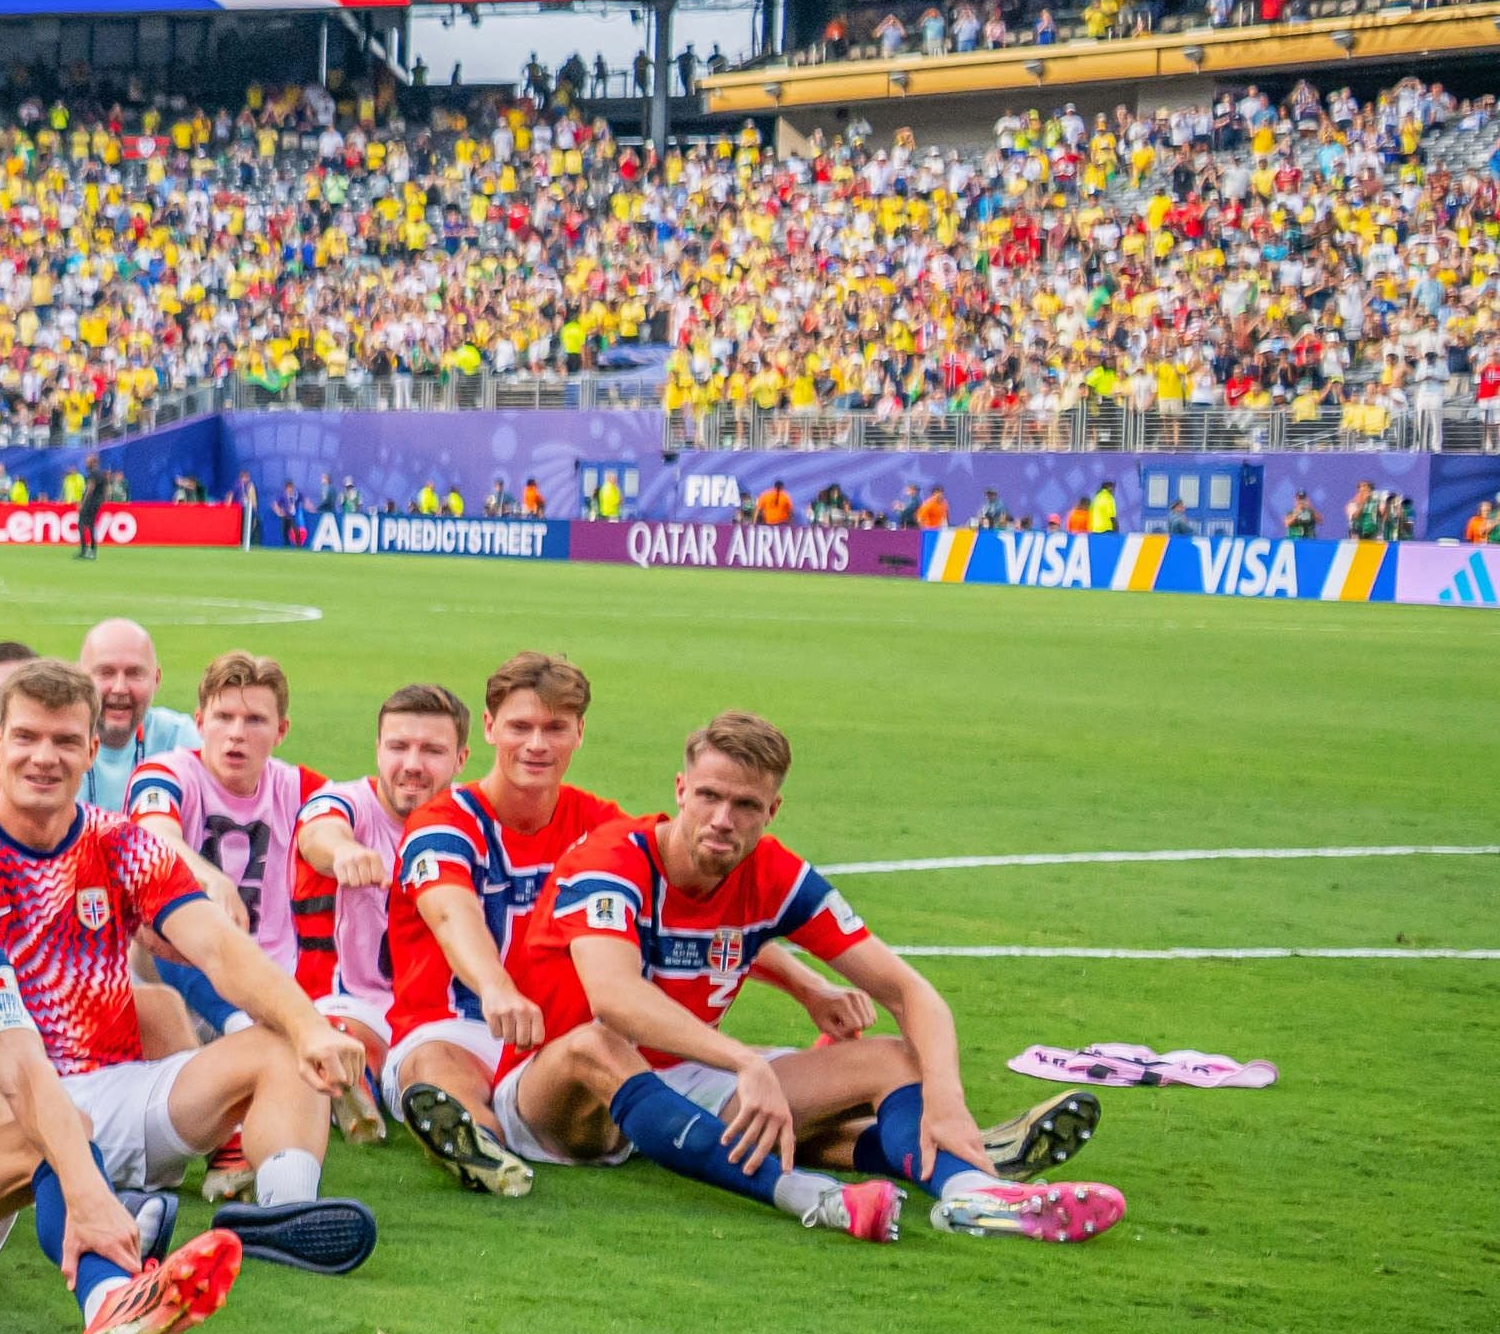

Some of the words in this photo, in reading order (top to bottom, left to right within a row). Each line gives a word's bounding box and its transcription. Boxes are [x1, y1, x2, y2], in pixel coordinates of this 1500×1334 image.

[685, 474, 742, 508] FIFA
[312, 512, 379, 554] ADI
[382, 518, 548, 557] PREDICTSTREET
[627, 521, 718, 568] QATAR
[727, 524, 850, 572] AIRWAYS
[997, 530, 1092, 588] VISA
[1190, 535, 1299, 598] VISA
